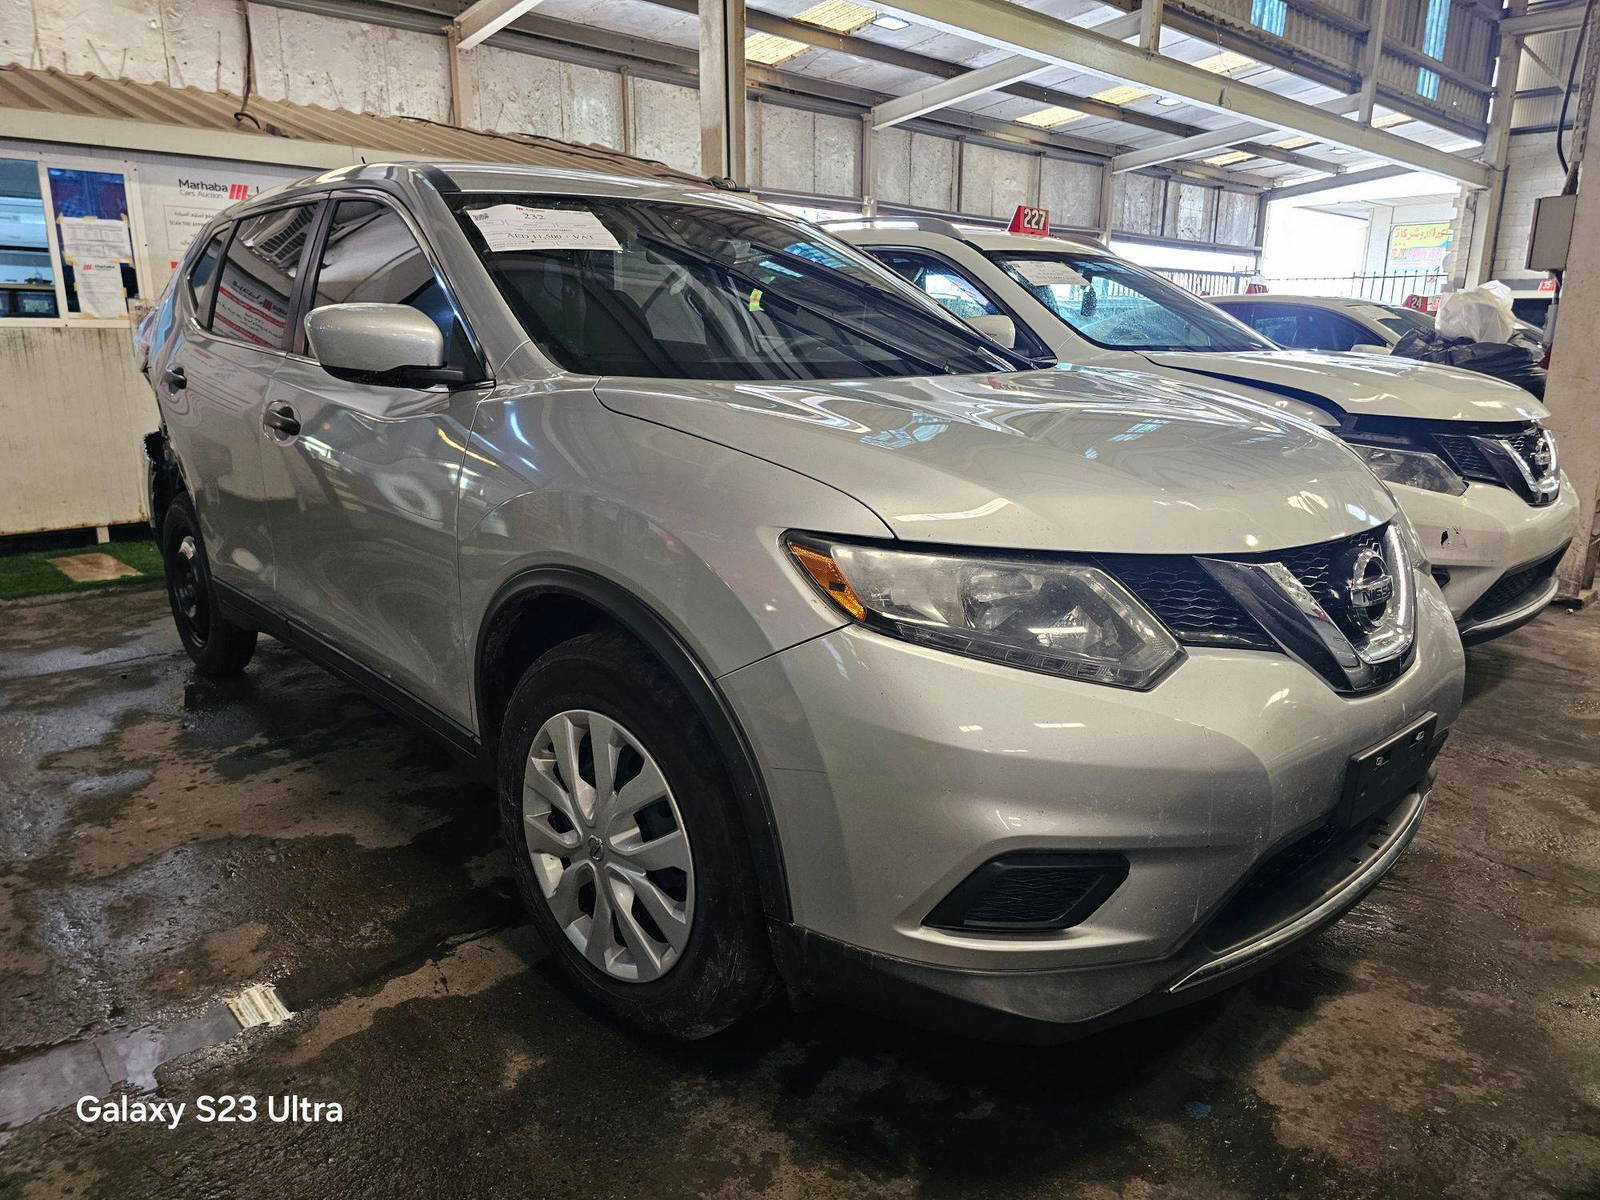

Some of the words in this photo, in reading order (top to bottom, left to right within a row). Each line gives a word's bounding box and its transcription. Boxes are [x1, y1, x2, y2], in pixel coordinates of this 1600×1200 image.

[178, 179, 228, 193] Marhaba
[180, 189, 196, 197] Cars
[197, 190, 223, 199] Auction
[522, 212, 545, 220] 232
[1024, 208, 1046, 230] 227
[1362, 582, 1393, 603] NISSA
